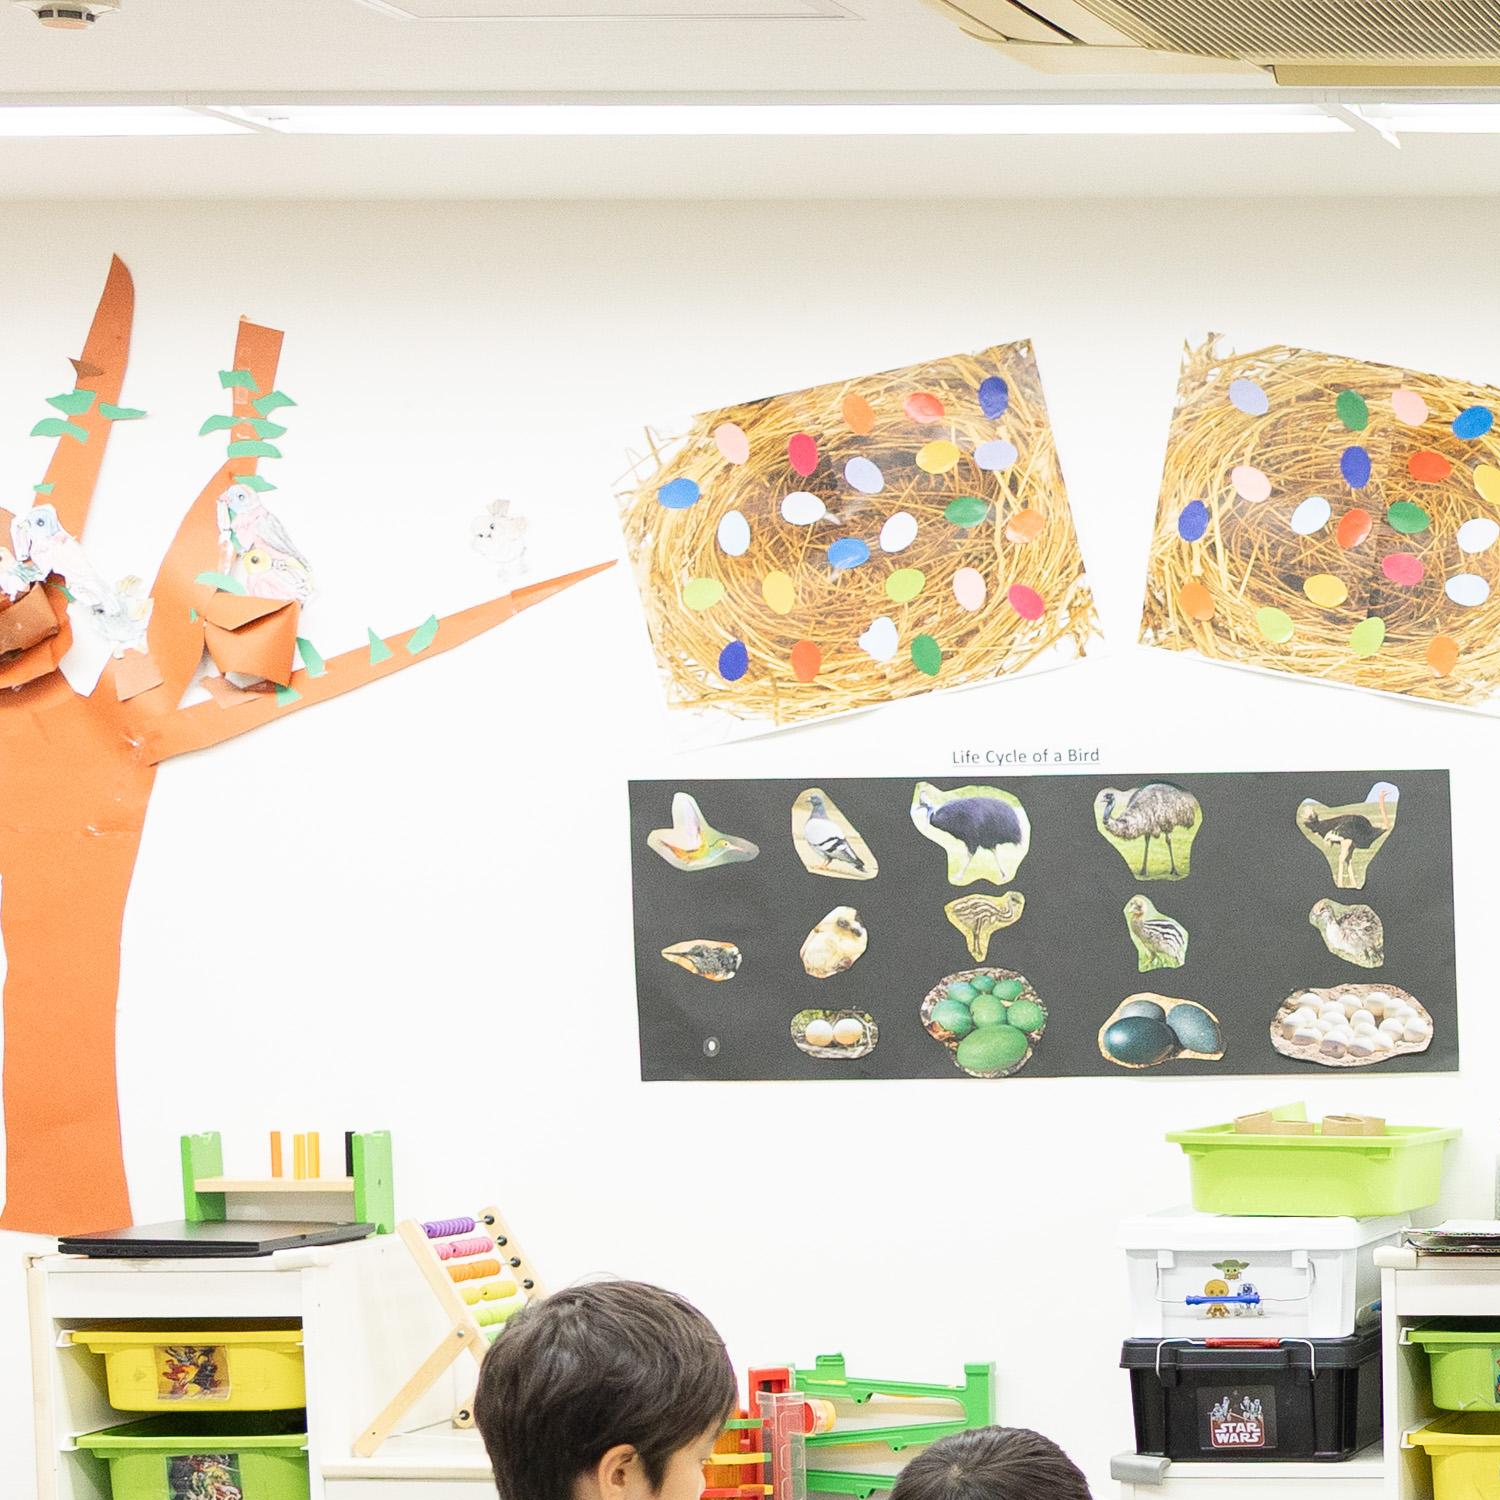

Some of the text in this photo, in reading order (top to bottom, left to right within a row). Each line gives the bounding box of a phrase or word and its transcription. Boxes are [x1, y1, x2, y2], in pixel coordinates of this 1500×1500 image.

[952, 747, 1100, 766] Life Cycle of a Bird
[1215, 1422, 1261, 1433] STAR
[1216, 1433, 1261, 1444] WARS
